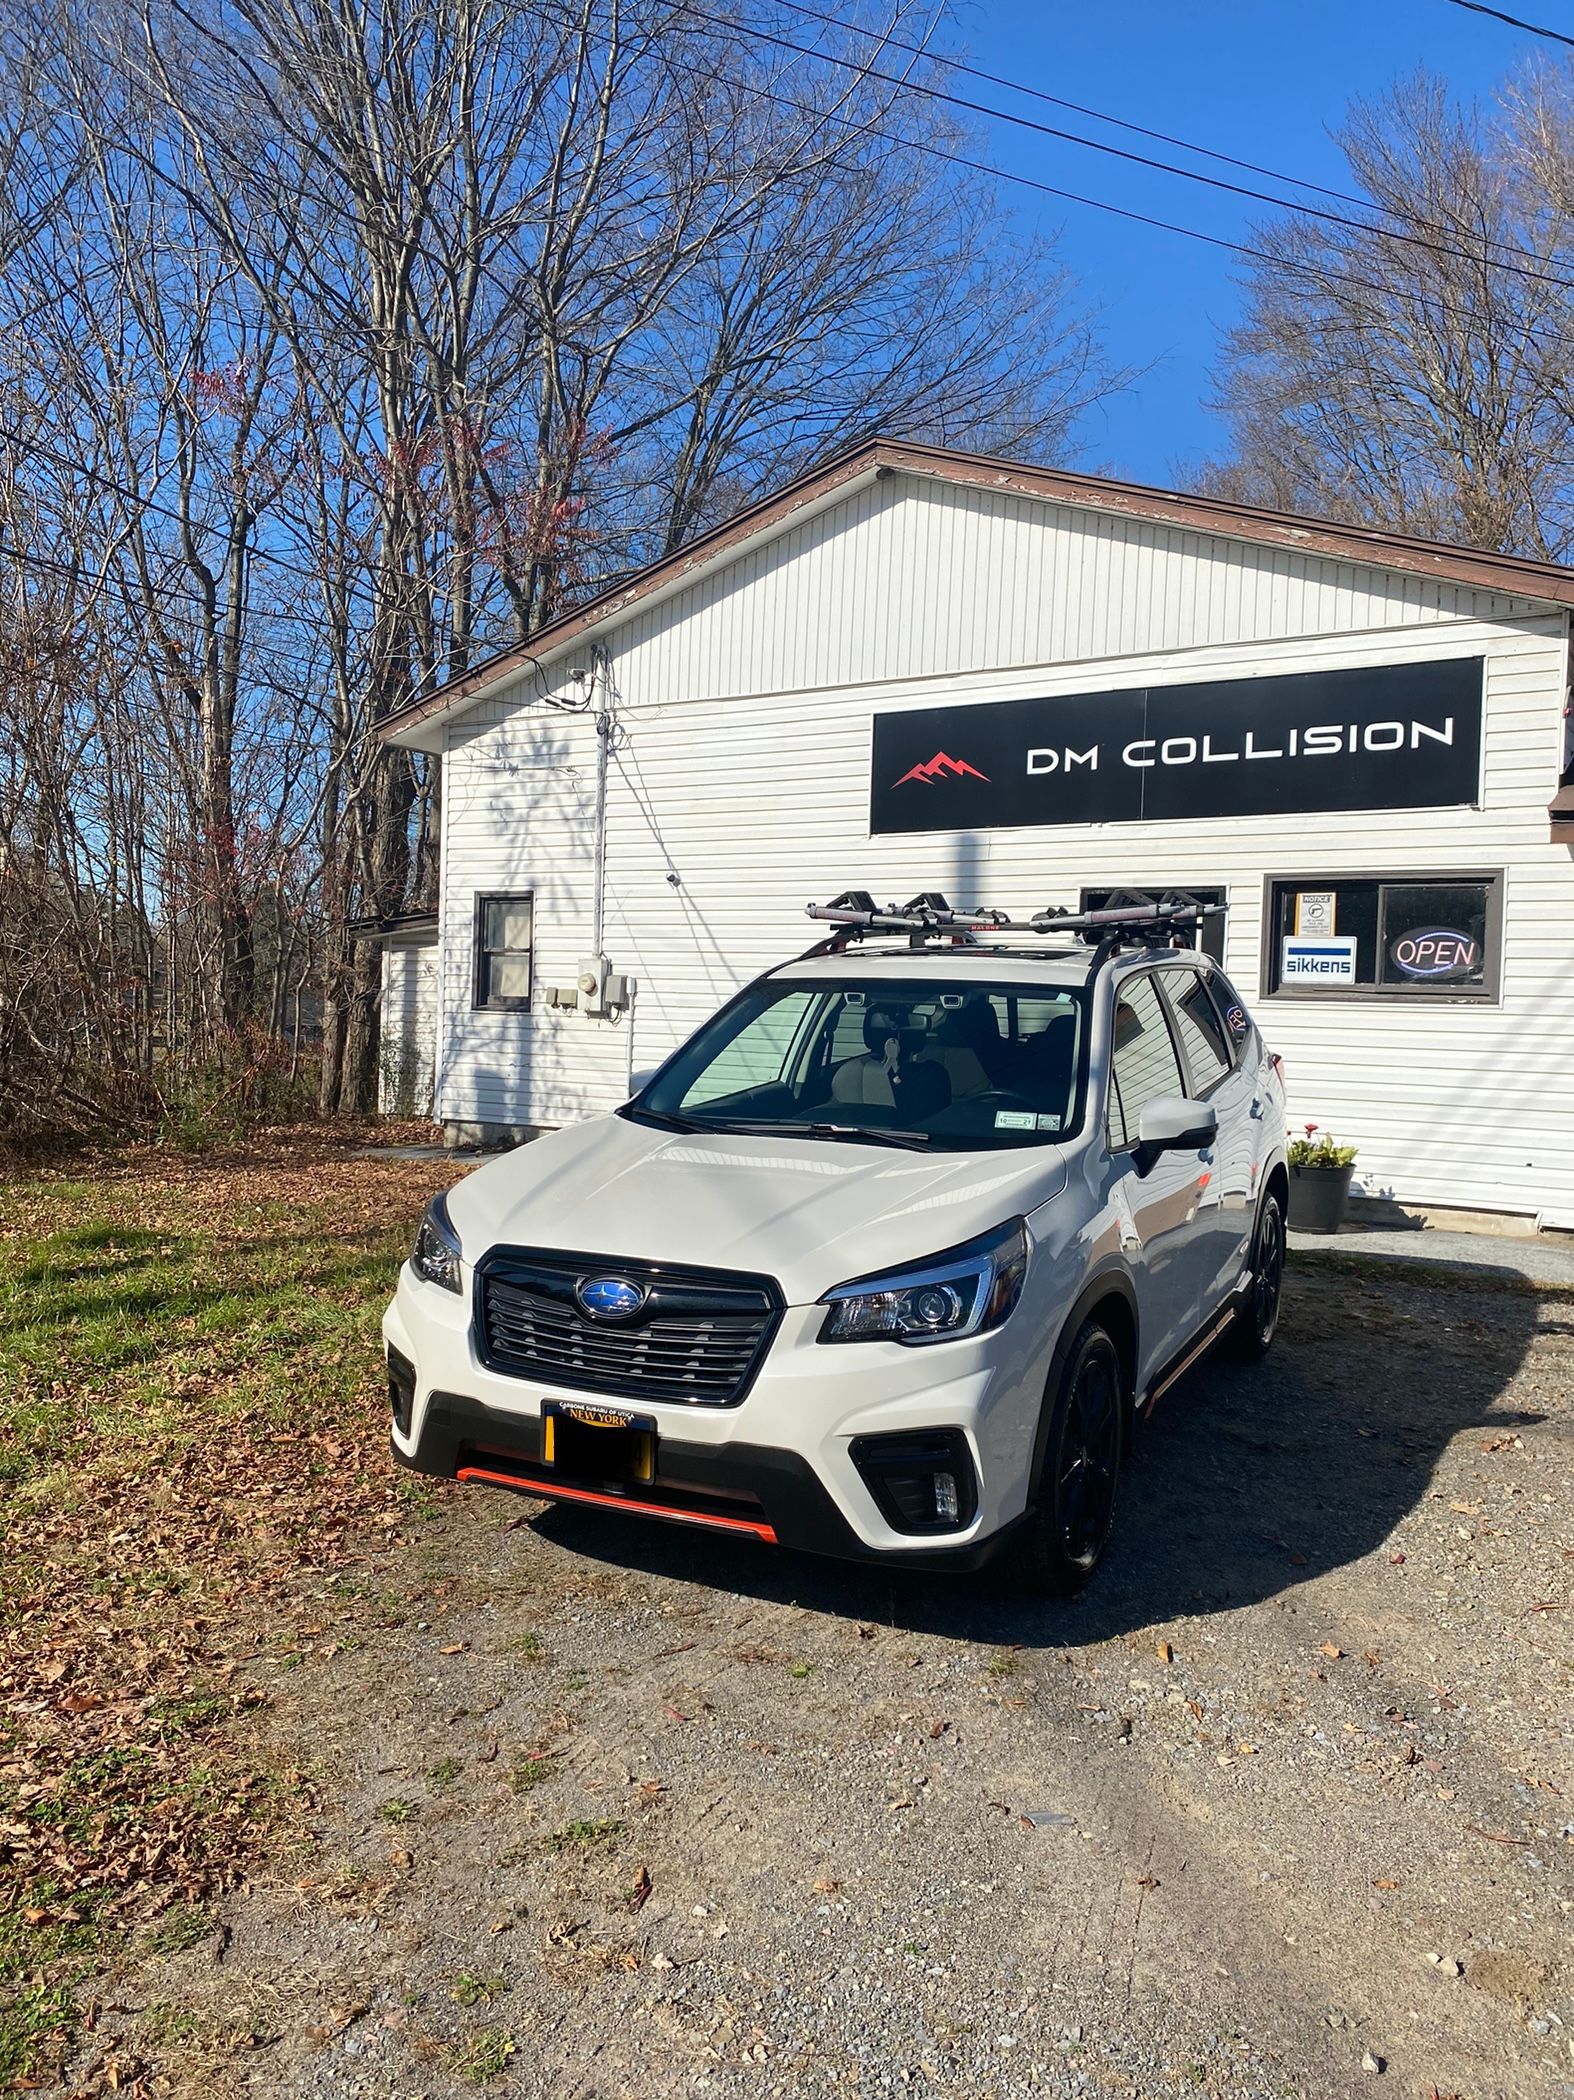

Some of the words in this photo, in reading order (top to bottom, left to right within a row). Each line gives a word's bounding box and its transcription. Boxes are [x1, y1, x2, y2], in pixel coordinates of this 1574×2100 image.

[1026, 744, 1098, 775] DM
[1122, 717, 1454, 768] COLLISION
[1303, 895, 1330, 903] NOTICE
[1396, 940, 1475, 965] OPEN
[1286, 957, 1351, 974] sikkens
[559, 1401, 585, 1410] CARBONE
[586, 1406, 607, 1414] SUBARU
[570, 1408, 595, 1420] NEW
[599, 1413, 627, 1426] YORK
